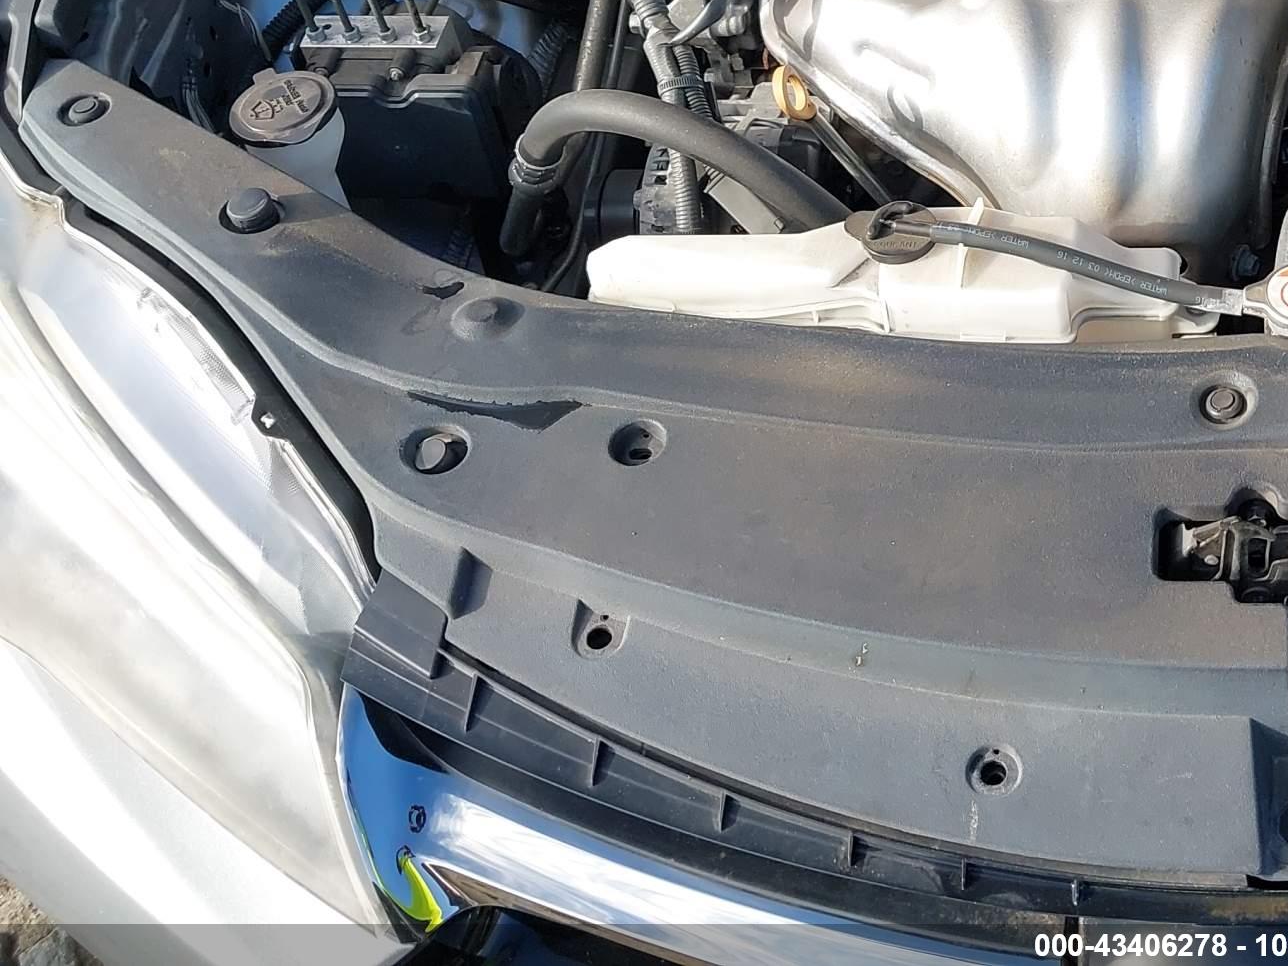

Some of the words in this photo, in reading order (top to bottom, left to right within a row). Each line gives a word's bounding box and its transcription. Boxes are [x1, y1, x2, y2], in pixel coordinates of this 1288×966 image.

[1056, 250, 1067, 261] 16
[1072, 256, 1084, 266] 12
[1087, 261, 1100, 273] 03
[1140, 282, 1168, 296] WATER
